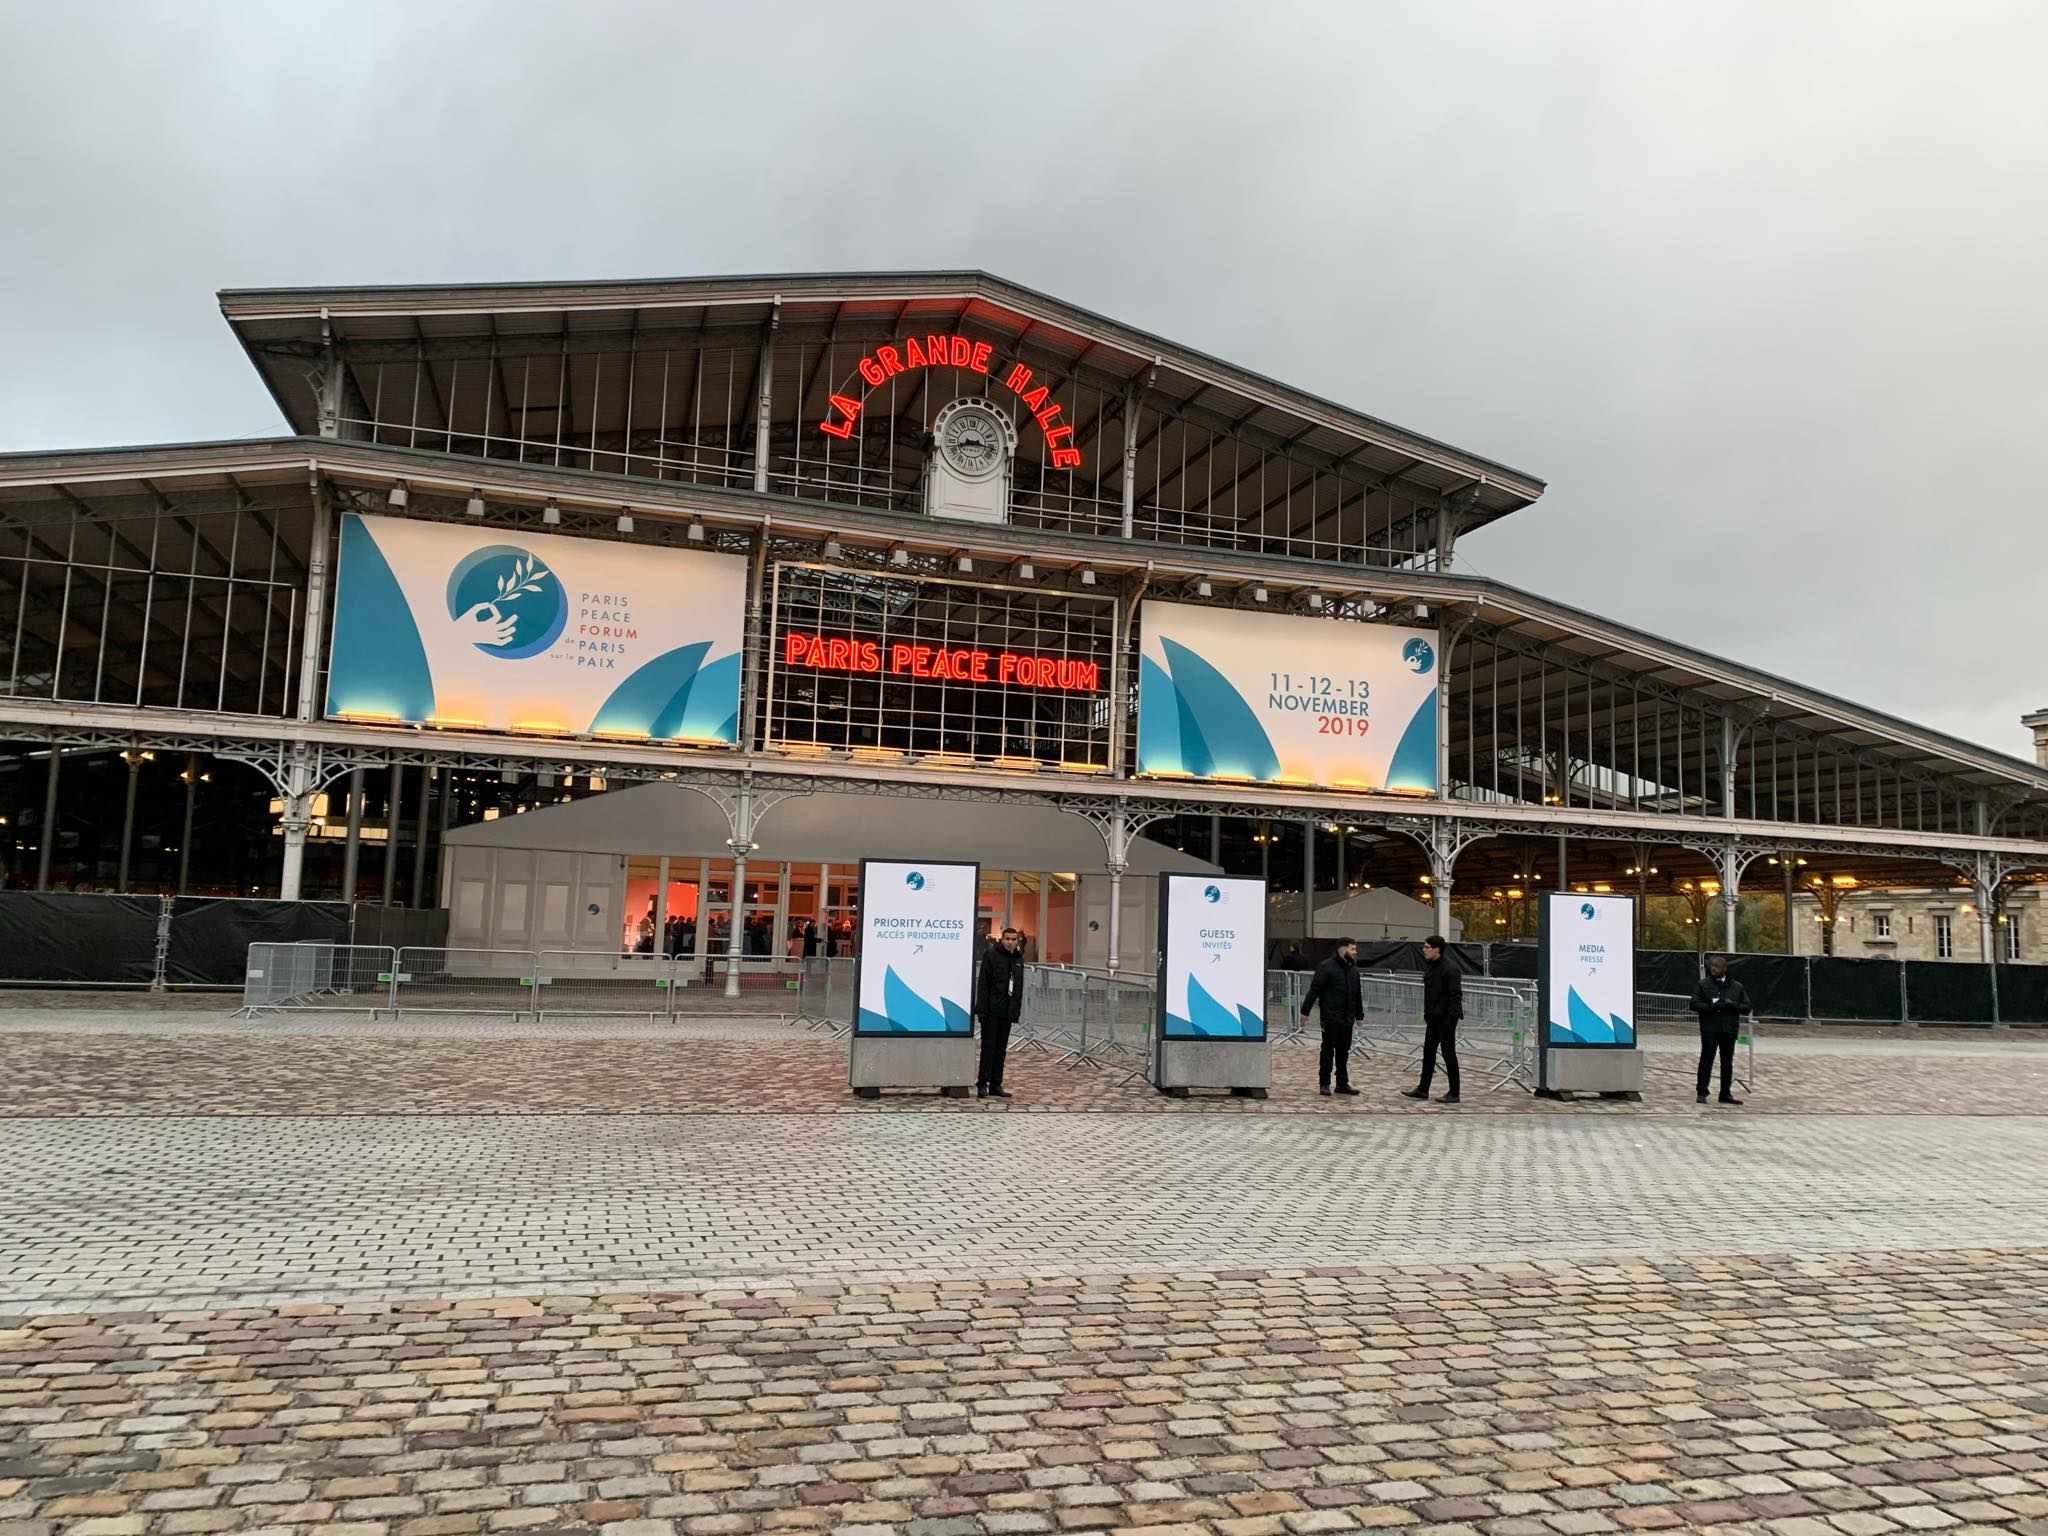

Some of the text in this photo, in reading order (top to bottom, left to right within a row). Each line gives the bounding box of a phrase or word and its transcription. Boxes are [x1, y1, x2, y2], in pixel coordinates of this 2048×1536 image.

[819, 394, 864, 439] LA
[859, 335, 993, 386] GRANDE
[1006, 363, 1081, 469] HALLE
[582, 593, 628, 607] PARIS
[581, 609, 631, 623] PEACE
[580, 624, 637, 639] FORUM
[579, 640, 625, 654] PARIS
[578, 656, 615, 669] PAIX
[783, 633, 1099, 691] PARIS PEACE FORUM
[1269, 693, 1369, 717] NOVEMBER
[1318, 716, 1369, 737] 2019
[873, 918, 964, 929] PRIORITY ACCESS
[907, 931, 960, 941] PRIORITAIRE
[1200, 929, 1235, 939] GUESTS
[1579, 944, 1605, 953] MEDIA
